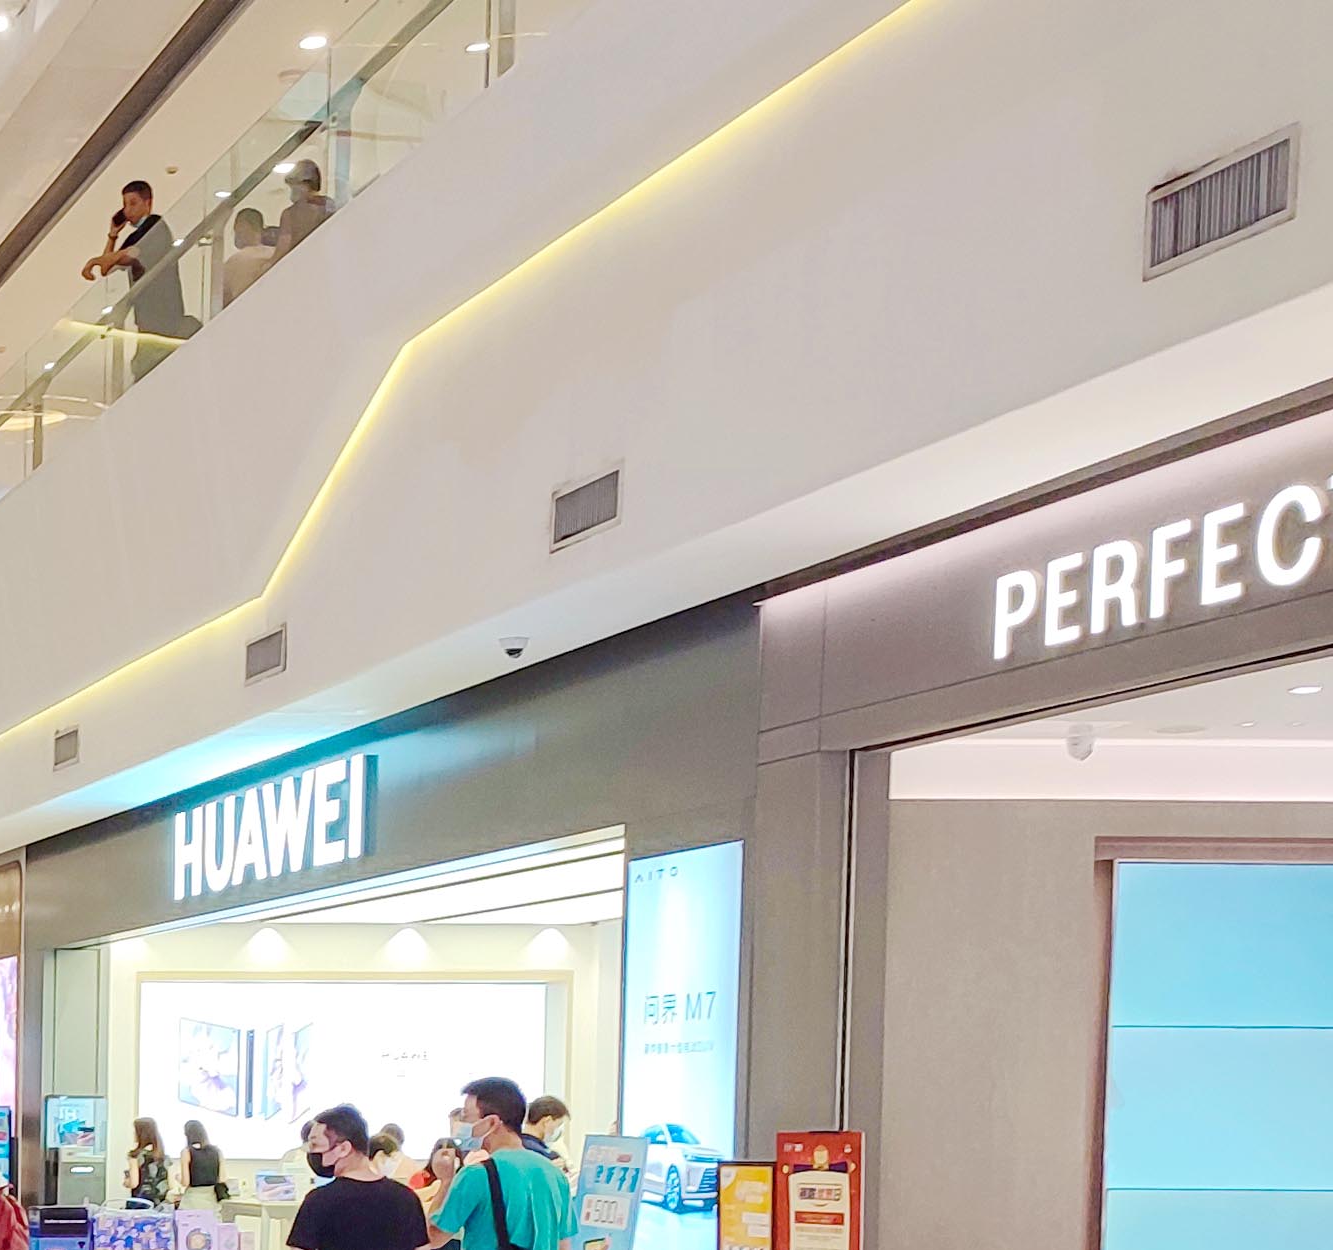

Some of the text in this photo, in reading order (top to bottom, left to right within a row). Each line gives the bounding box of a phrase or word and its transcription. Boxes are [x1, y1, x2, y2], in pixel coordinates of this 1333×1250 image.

[993, 475, 1333, 661] PERFEC
[173, 753, 365, 901] HUAWEI
[643, 991, 717, 1025] 问界 M7
